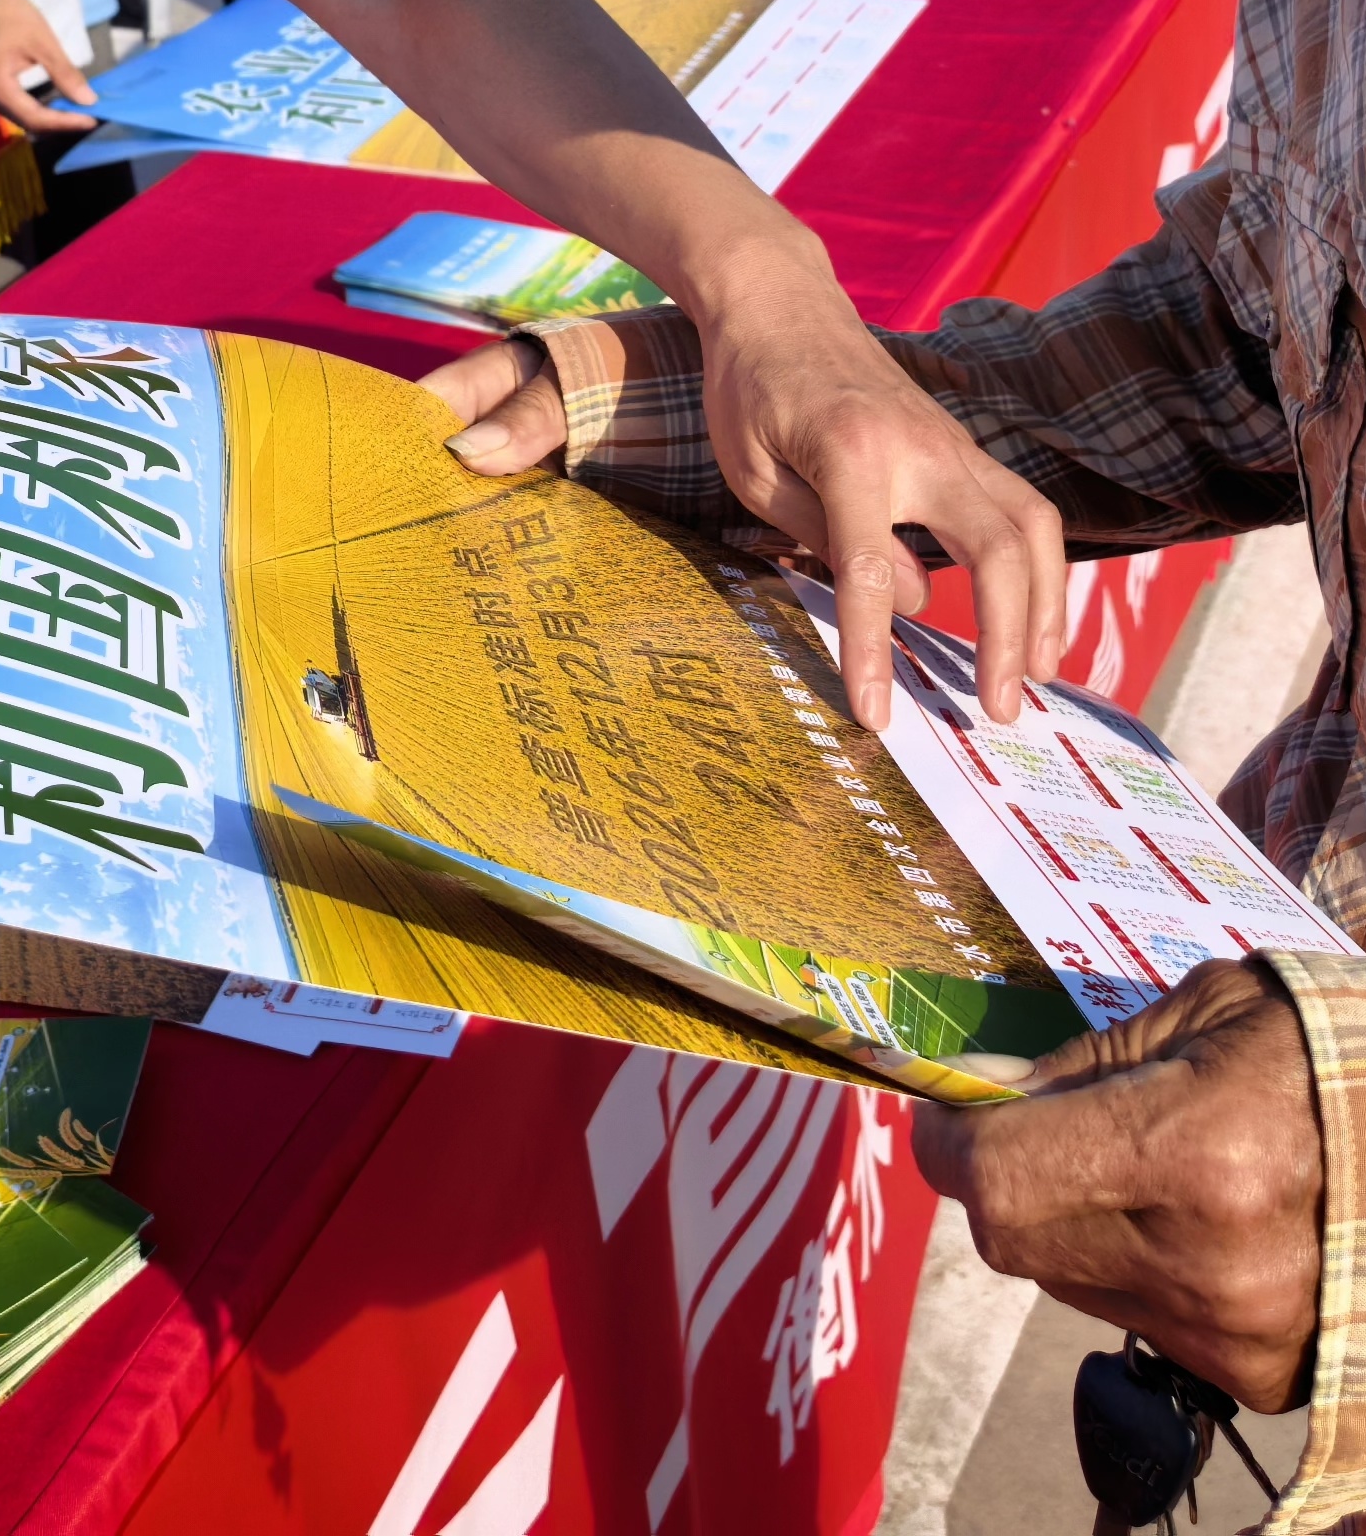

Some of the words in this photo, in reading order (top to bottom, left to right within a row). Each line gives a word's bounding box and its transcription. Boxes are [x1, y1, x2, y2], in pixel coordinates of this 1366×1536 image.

[453, 543, 622, 857] 普查标准时点
[503, 507, 737, 933] 2026年12月31日
[1045, 937, 1138, 1026] 羊年大吉
